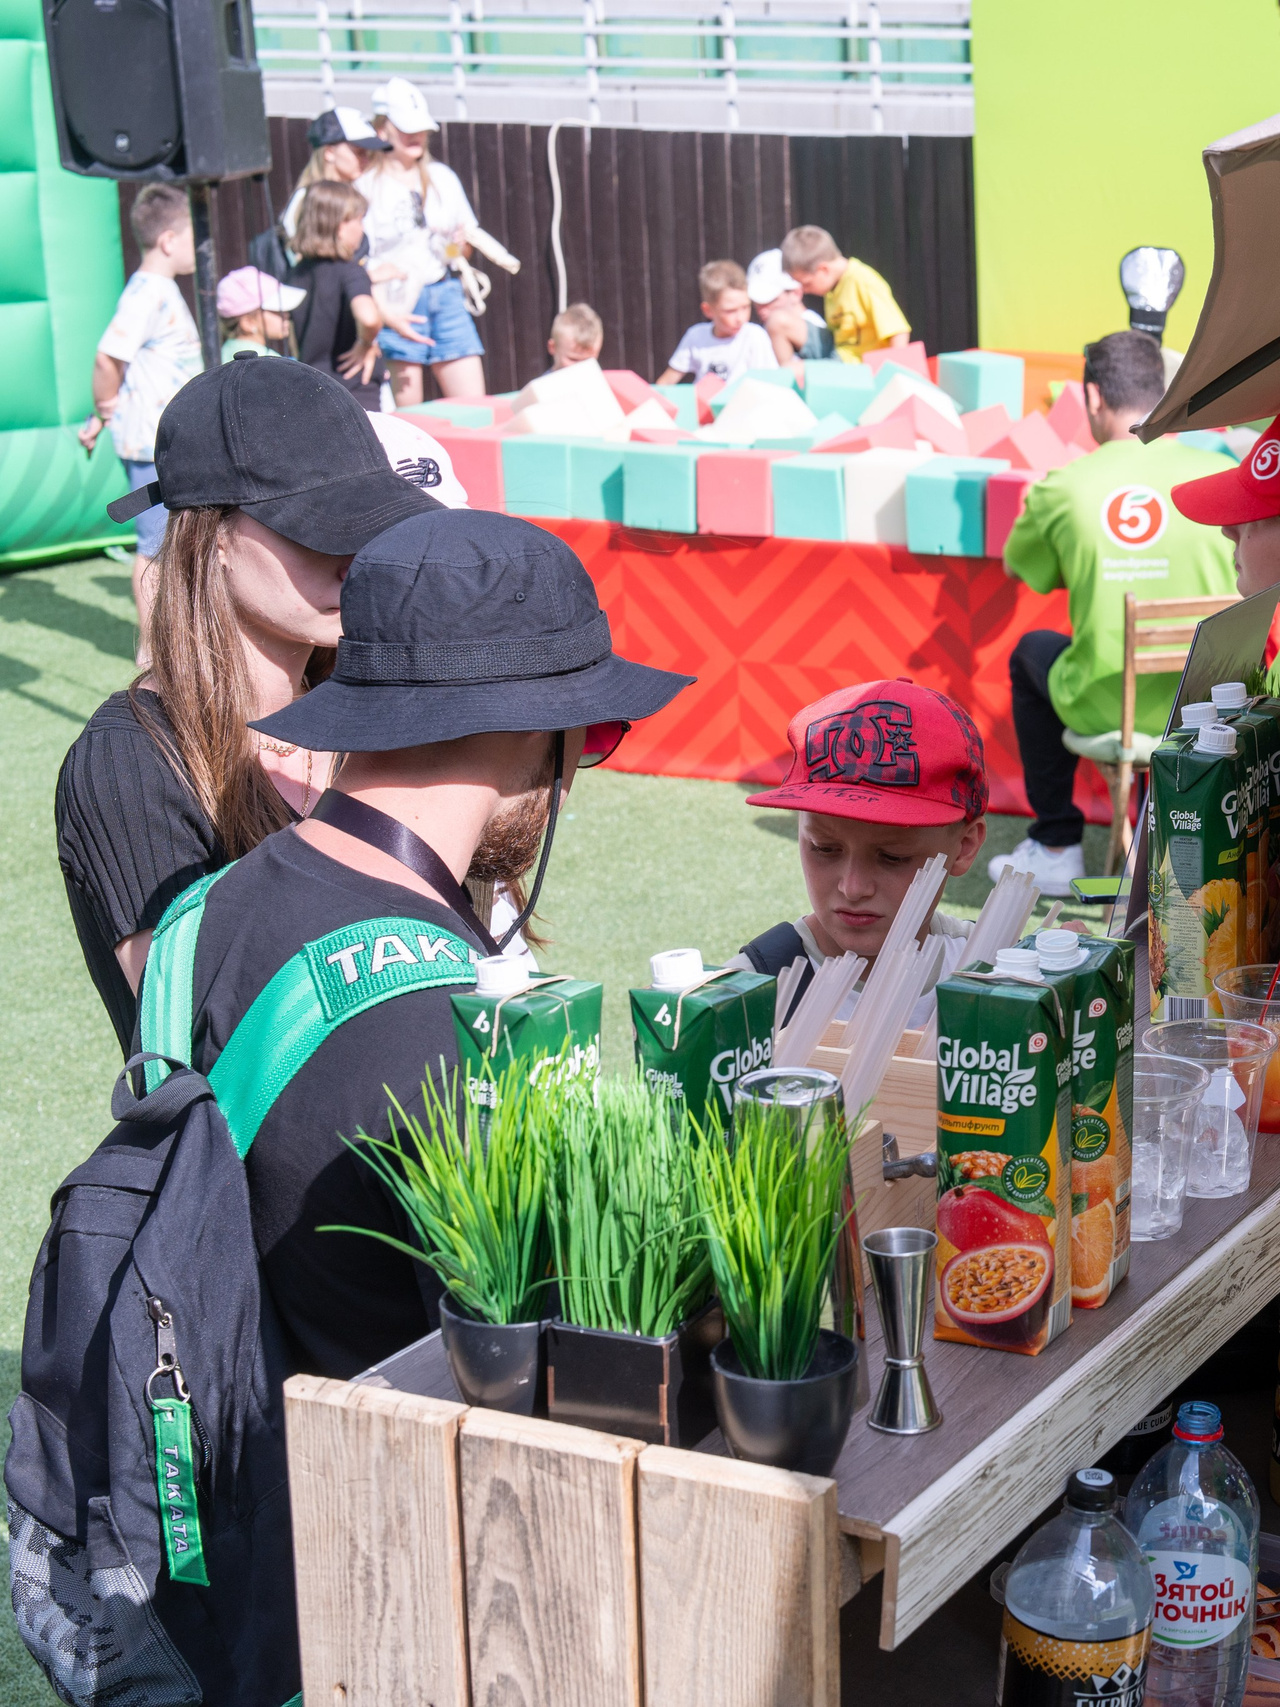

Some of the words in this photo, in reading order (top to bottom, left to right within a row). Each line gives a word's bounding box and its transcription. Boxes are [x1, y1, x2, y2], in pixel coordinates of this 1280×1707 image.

[1170, 810, 1198, 821] Global
[1172, 819, 1202, 832] Village
[937, 1036, 1022, 1073] Global
[940, 1067, 1038, 1115] Village
[163, 1445, 190, 1553] TAKATA
